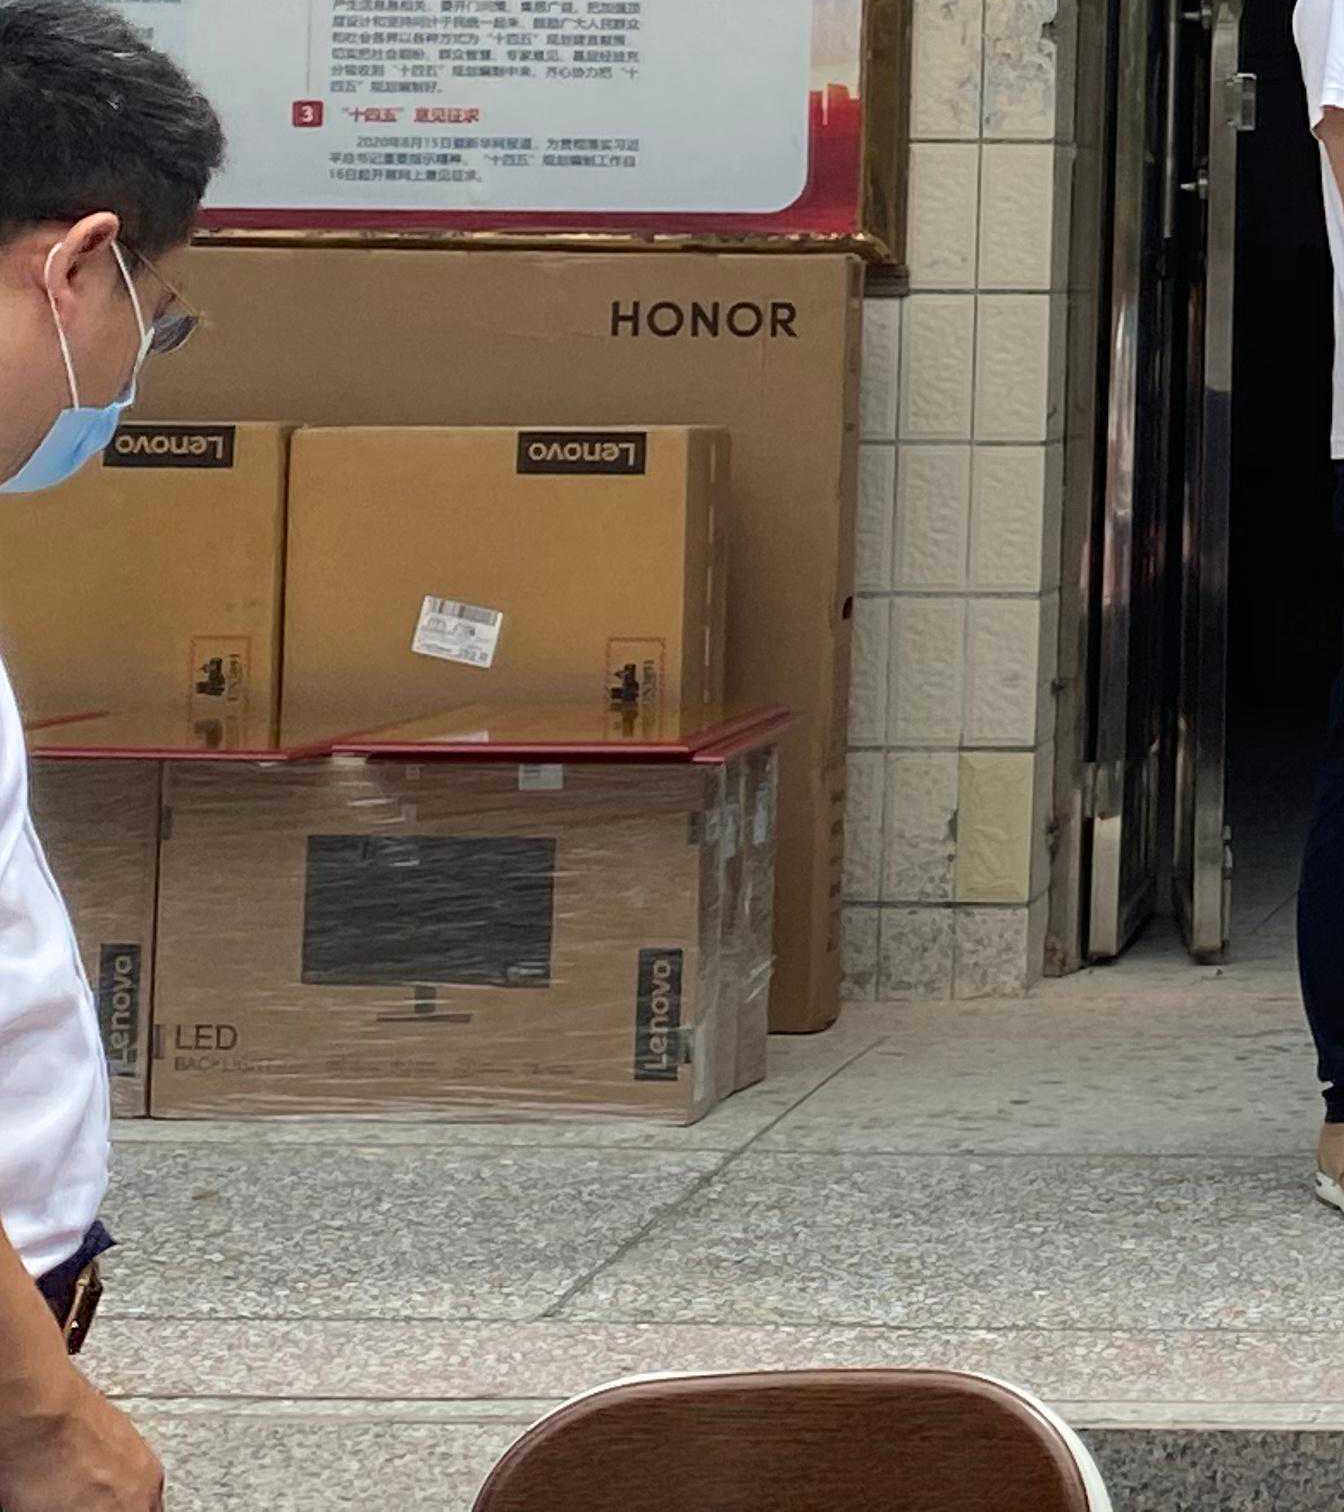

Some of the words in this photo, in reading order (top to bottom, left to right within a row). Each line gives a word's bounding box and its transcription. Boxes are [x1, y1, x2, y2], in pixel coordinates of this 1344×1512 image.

[610, 301, 798, 338] HONOR
[116, 435, 225, 460] Lenovo
[528, 442, 636, 466] Lenovo
[643, 958, 671, 1070] Lenovo
[175, 1024, 238, 1050] LED
